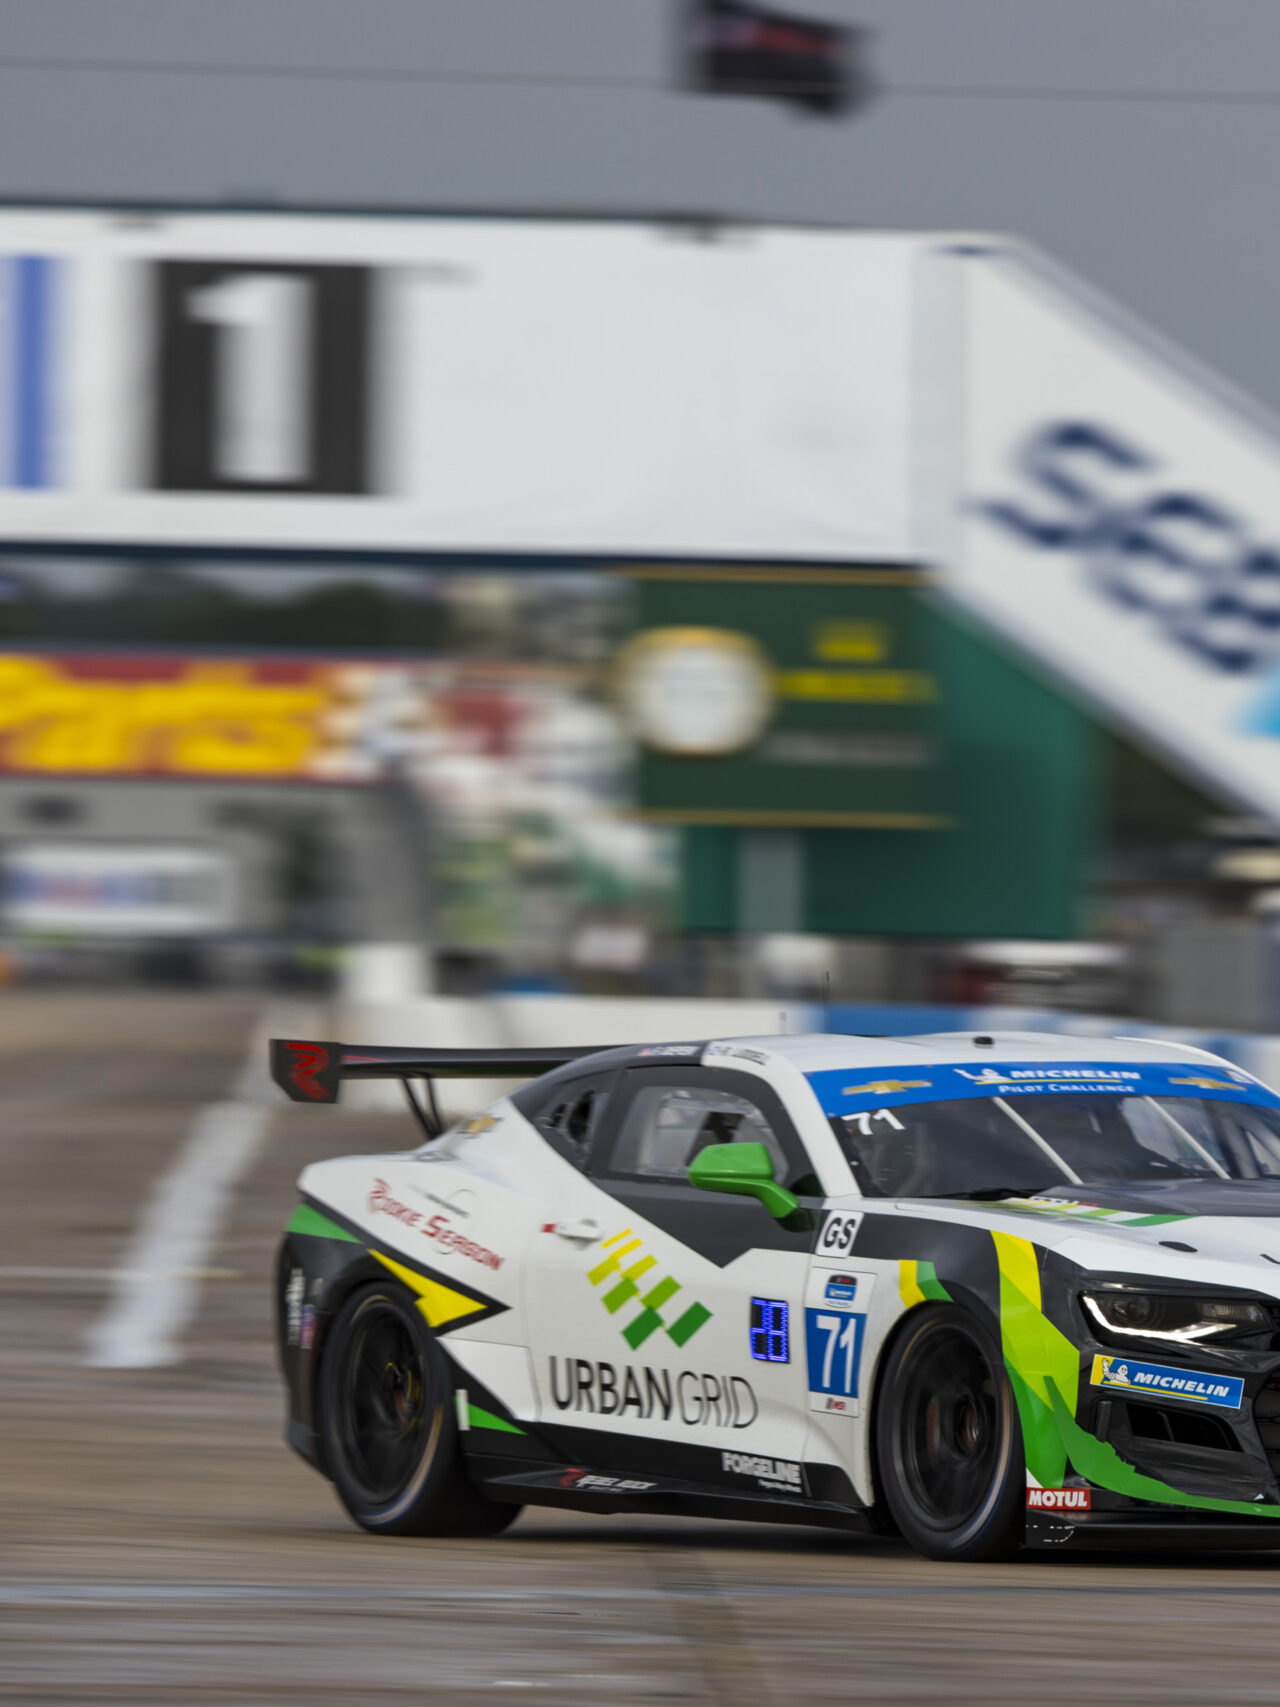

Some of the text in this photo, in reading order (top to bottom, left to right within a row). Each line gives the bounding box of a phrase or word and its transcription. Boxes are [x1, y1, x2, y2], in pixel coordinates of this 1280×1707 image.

[1010, 1069, 1142, 1081] MICHELIN
[841, 1107, 905, 1136] 71
[823, 1216, 856, 1250] GS
[815, 1314, 858, 1394] 71
[1133, 1372, 1231, 1398] MICHELIN
[720, 1451, 803, 1486] FORGELINE
[1028, 1489, 1089, 1508] MOTUL
